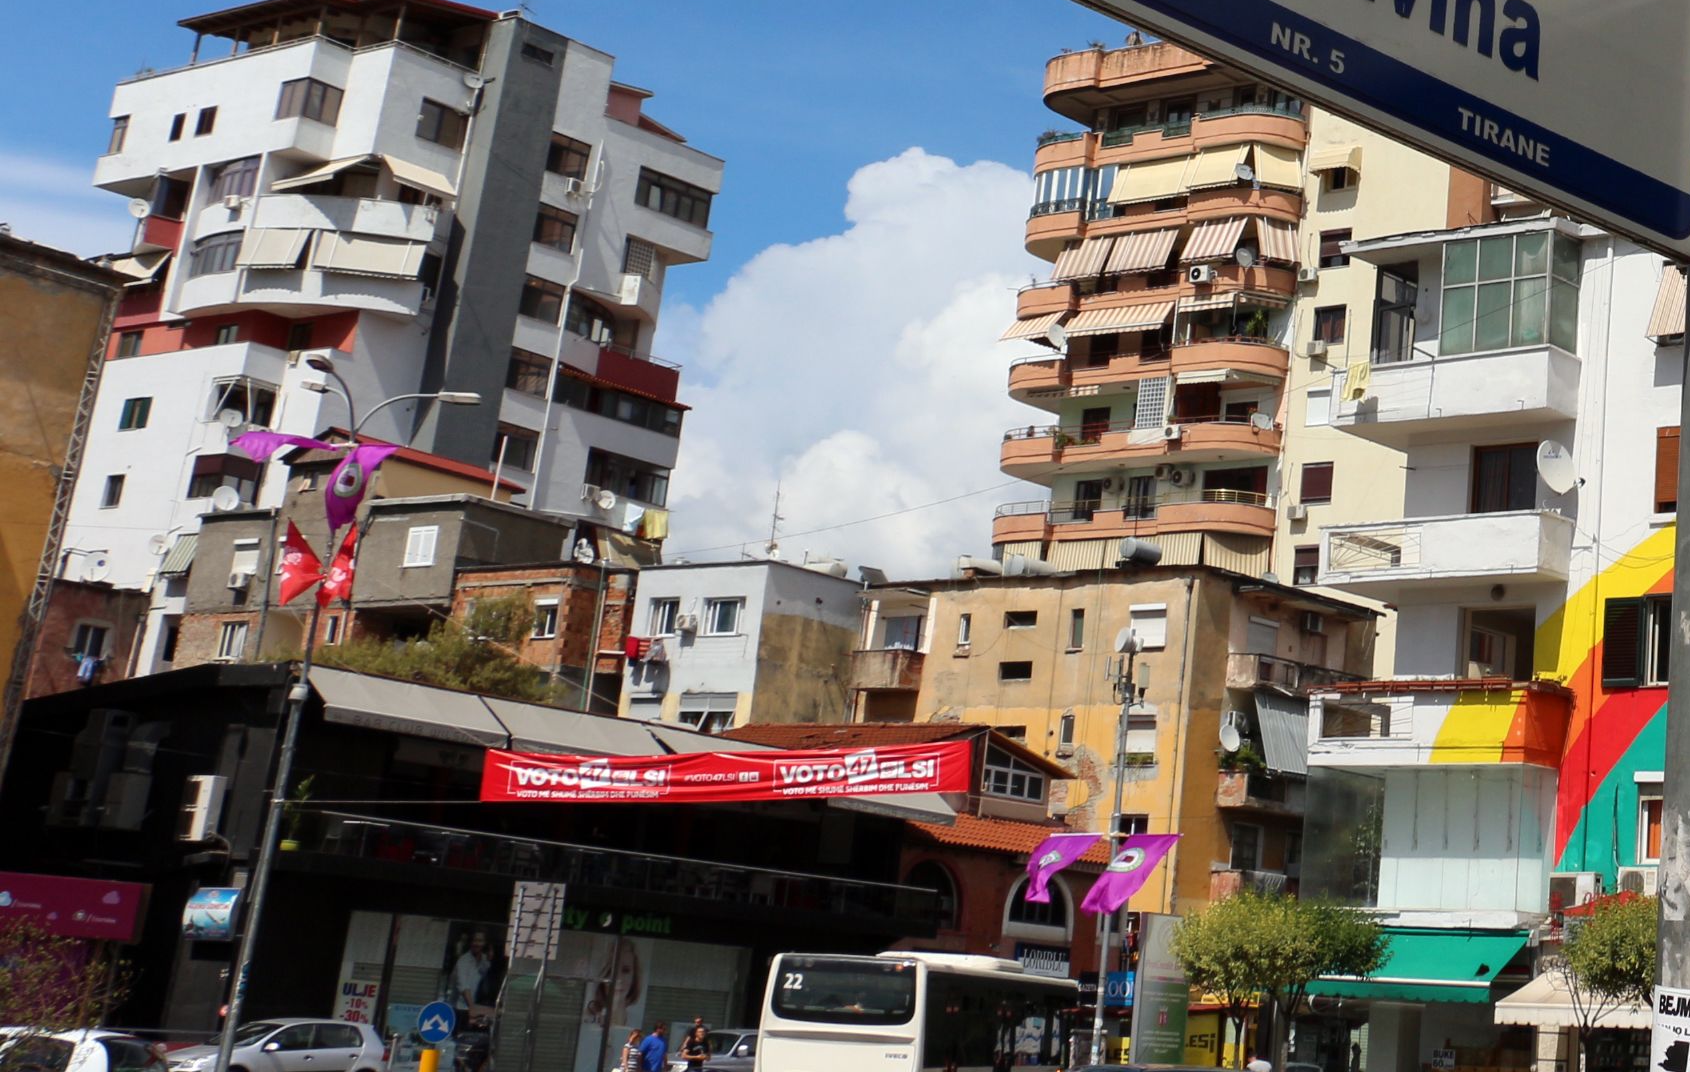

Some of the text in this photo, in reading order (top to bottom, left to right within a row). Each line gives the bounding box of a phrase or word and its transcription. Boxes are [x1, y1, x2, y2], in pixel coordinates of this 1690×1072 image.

[1270, 21, 1319, 64] NR.
[1329, 49, 1346, 75] 5
[1458, 106, 1551, 168] TIRANE
[516, 766, 578, 786] VOTO
[779, 755, 935, 784] VOTO 47 LSI
[343, 982, 377, 998] ULJE
[783, 973, 803, 990] 22
